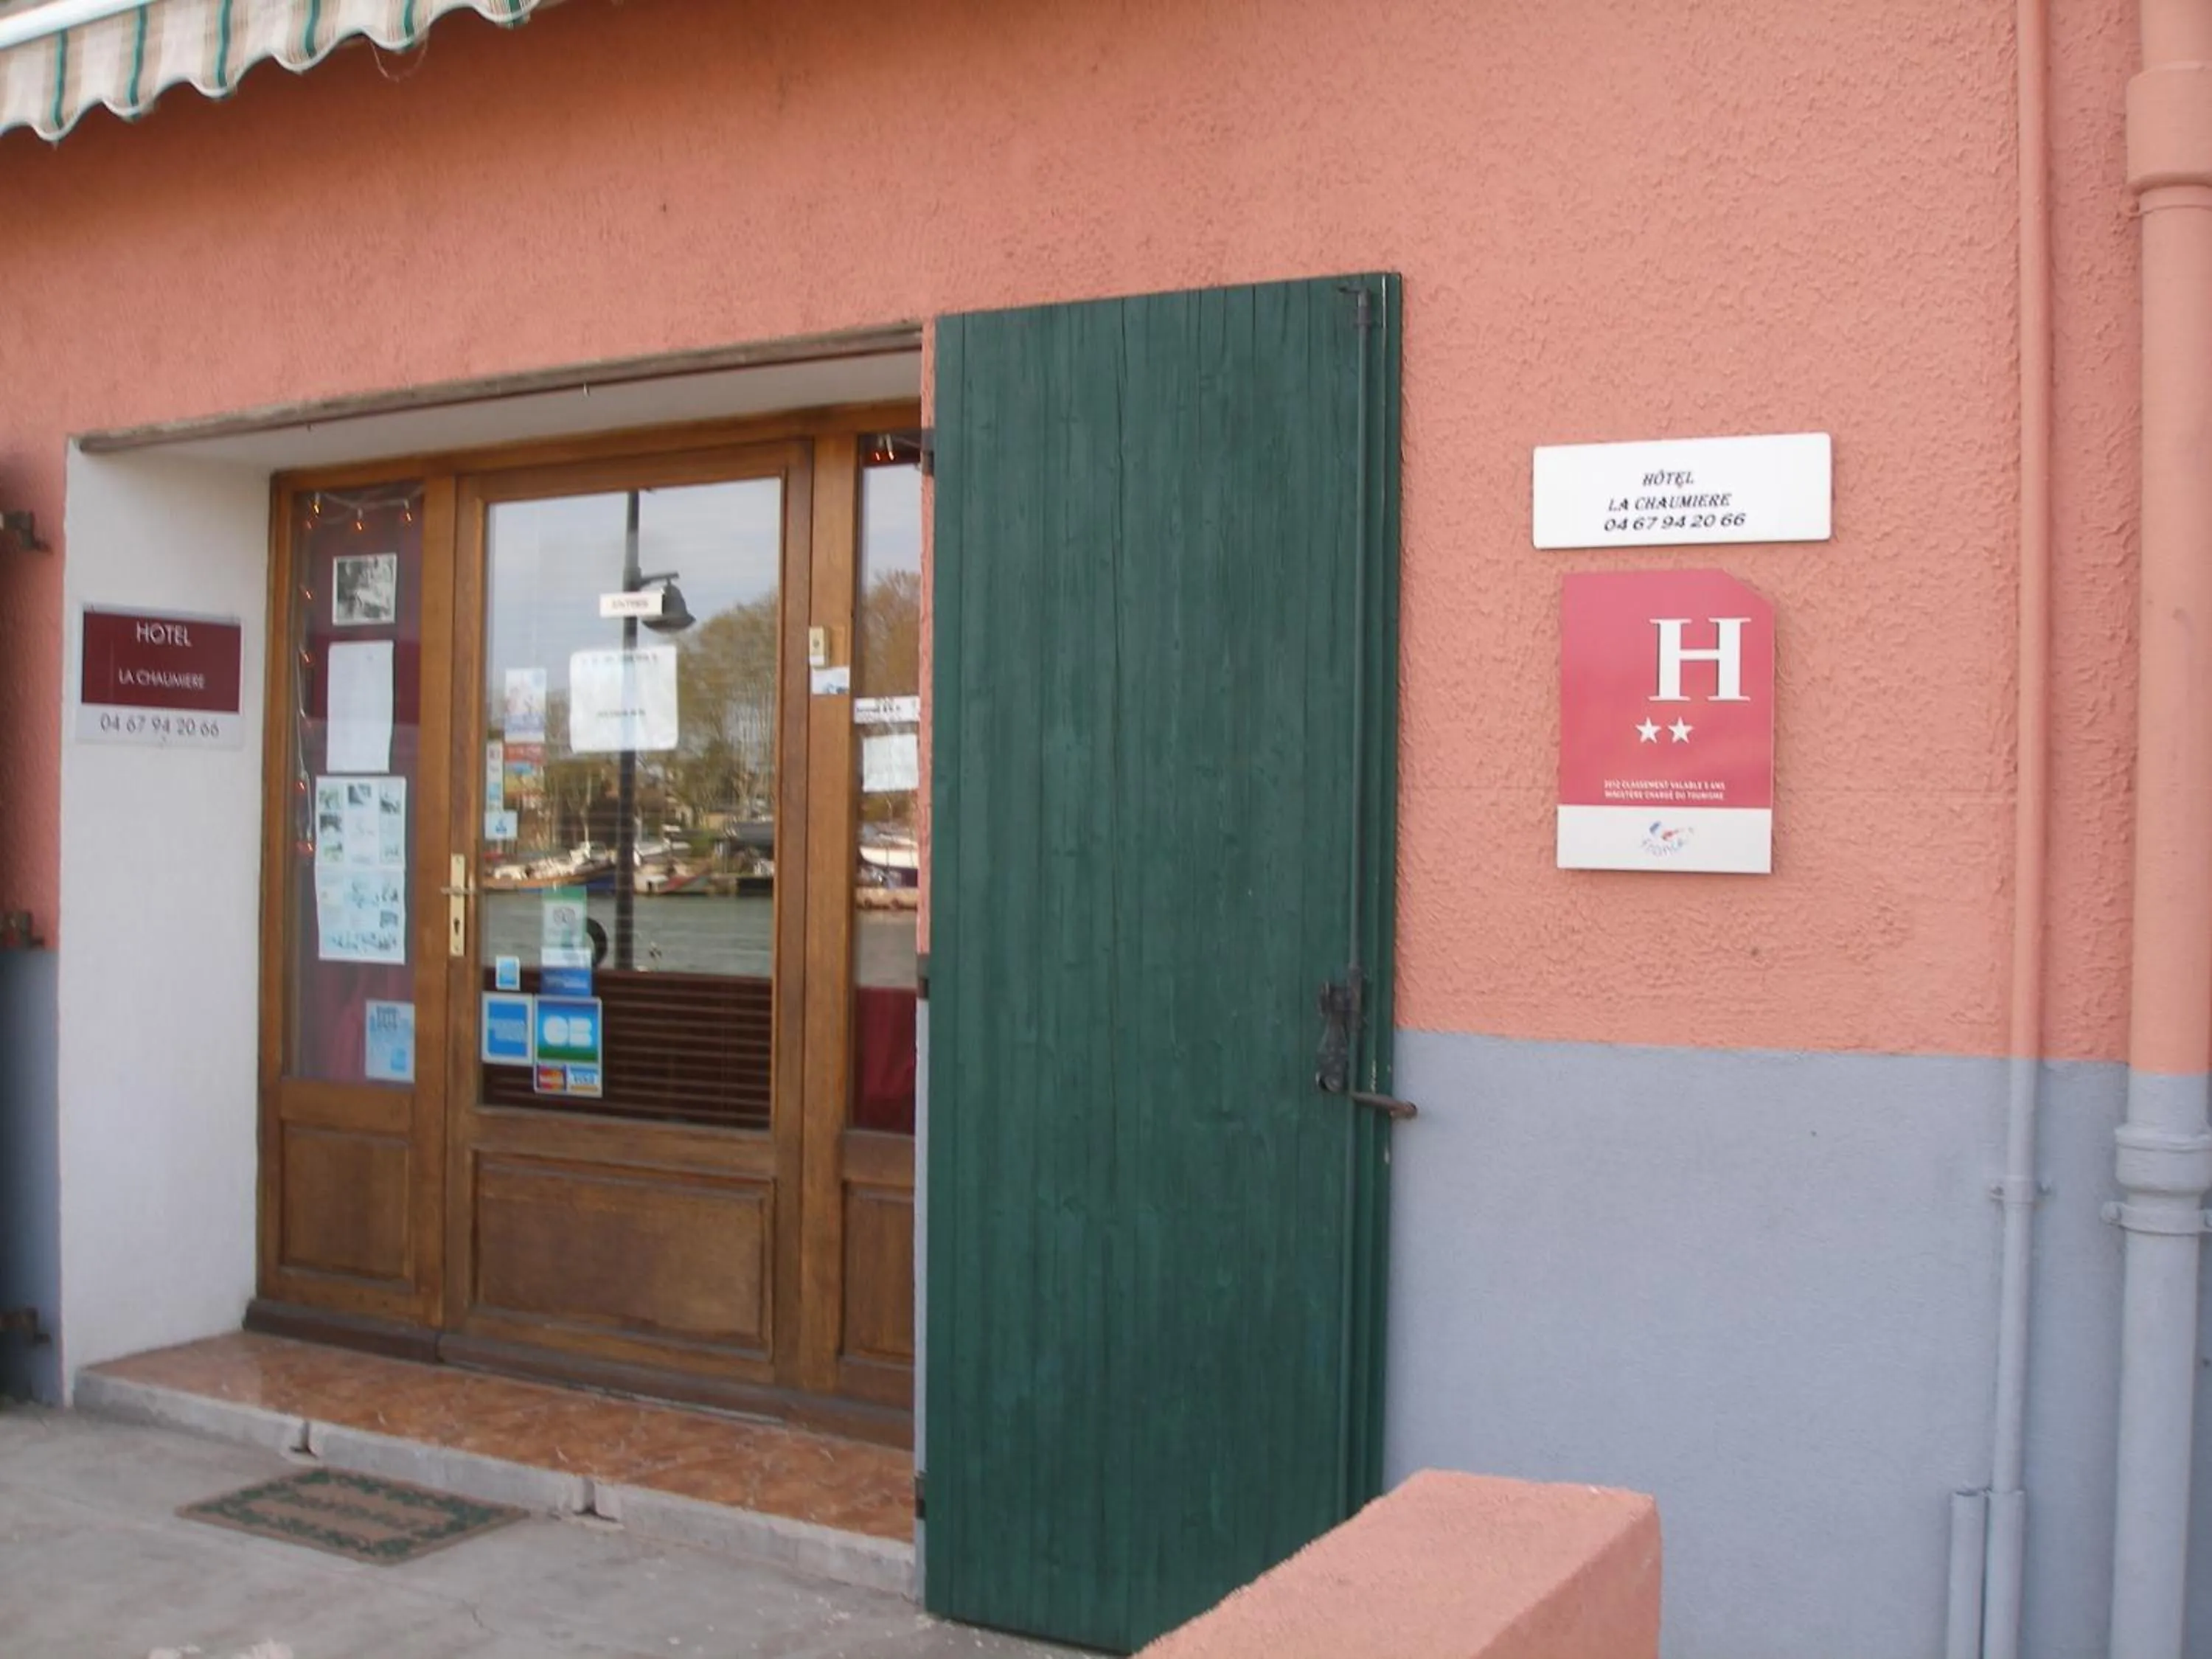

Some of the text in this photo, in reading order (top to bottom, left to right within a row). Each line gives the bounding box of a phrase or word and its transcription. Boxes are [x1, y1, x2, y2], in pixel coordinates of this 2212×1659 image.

[1642, 470, 1694, 488] HÔTEL
[1608, 493, 1732, 512] LA CHAUMIERE
[1604, 512, 1747, 532] 04 67 94 20 66
[1648, 616, 1752, 701] H
[118, 667, 134, 685] LA
[100, 714, 220, 738] 04 67 94 20 66
